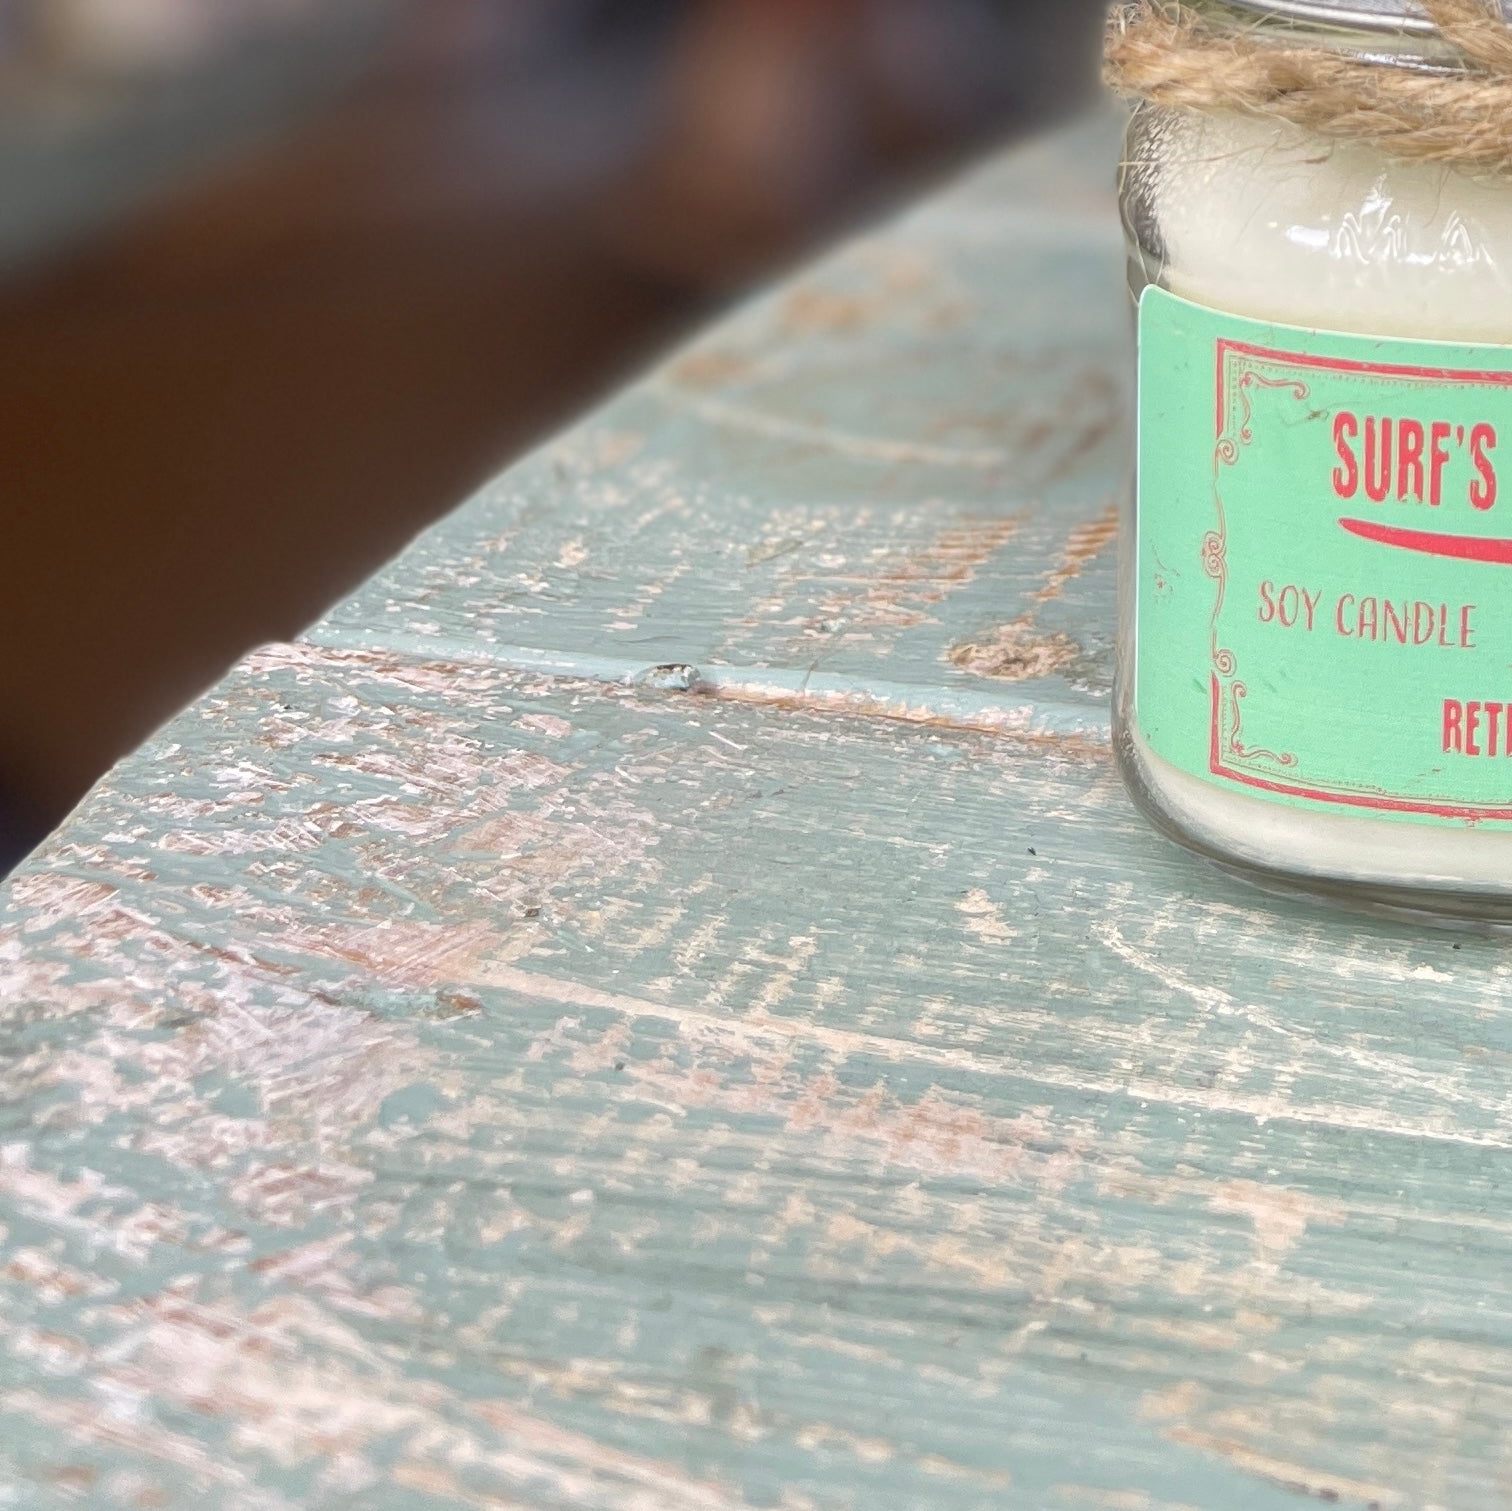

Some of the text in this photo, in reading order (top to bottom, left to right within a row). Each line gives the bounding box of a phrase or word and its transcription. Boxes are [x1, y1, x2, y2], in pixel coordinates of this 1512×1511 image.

[1332, 411, 1497, 511] SURF'S
[1256, 580, 1477, 649] SOY CANDLE
